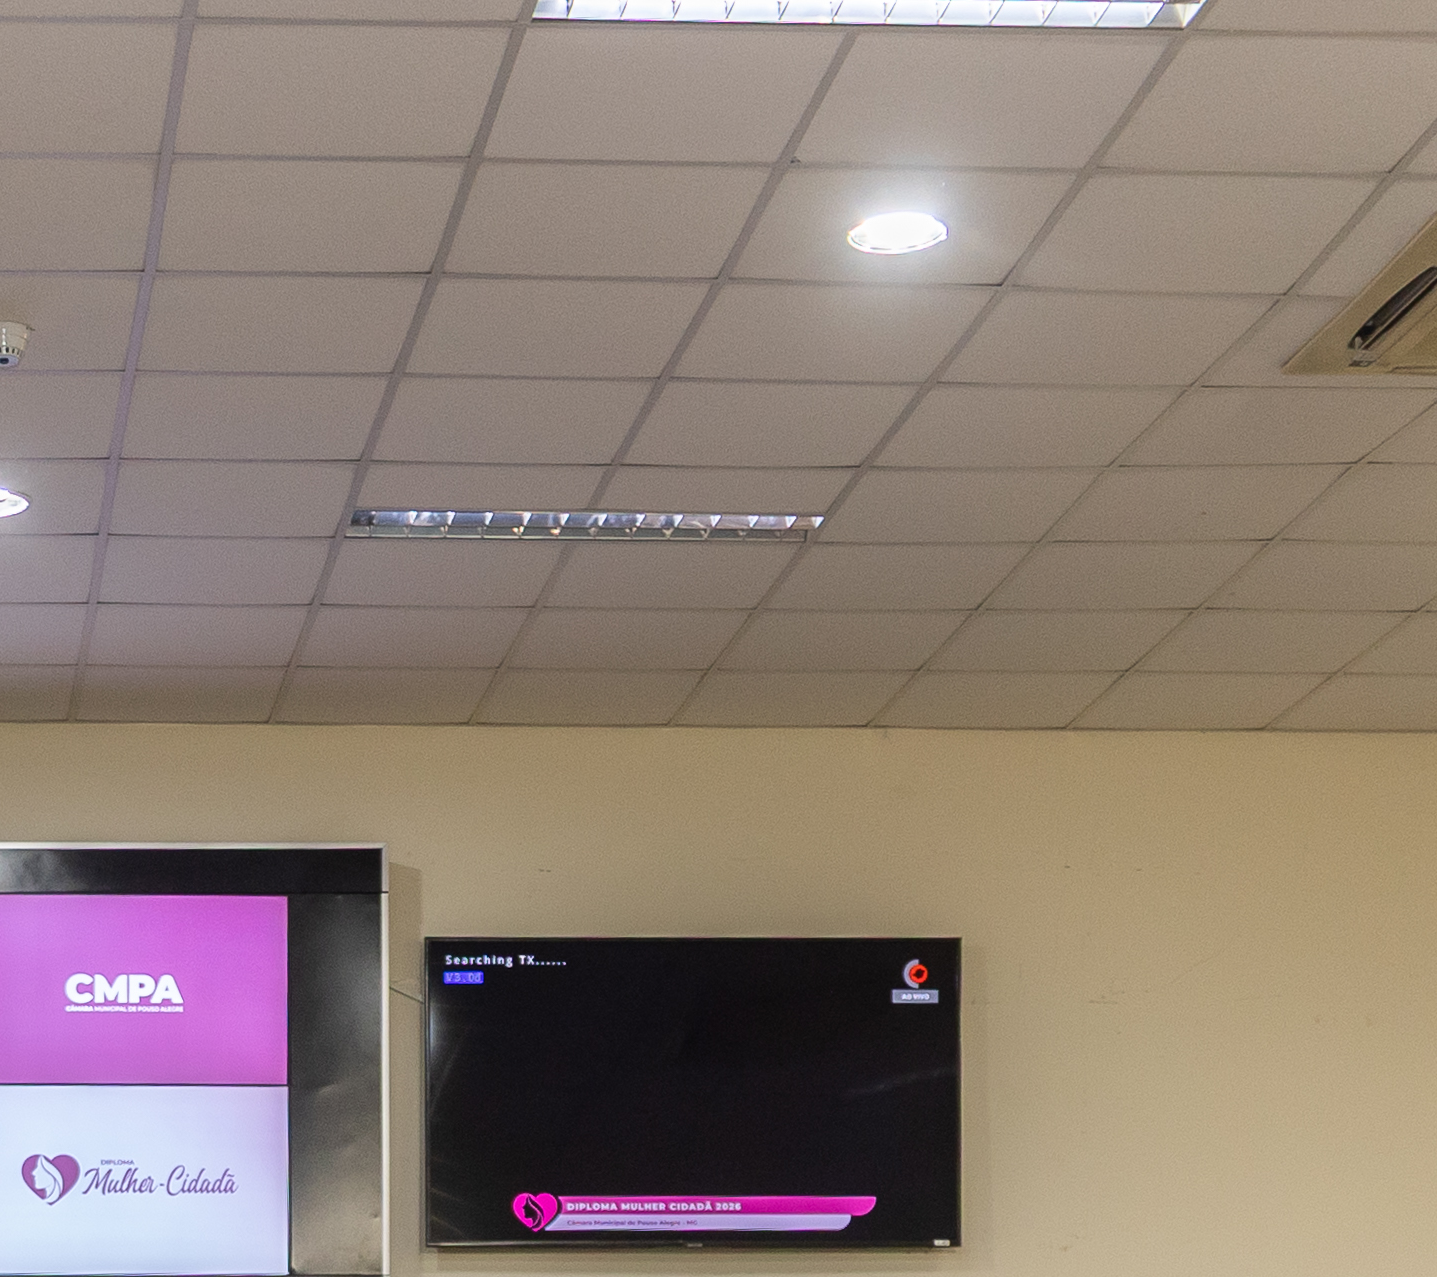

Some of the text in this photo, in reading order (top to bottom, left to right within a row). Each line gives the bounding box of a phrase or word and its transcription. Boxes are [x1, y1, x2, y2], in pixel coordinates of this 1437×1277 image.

[445, 954, 513, 968] Searching
[65, 972, 184, 1004] CMPA
[566, 1200, 742, 1211] DIPLOMA MULHER CIDADÃ 2026
